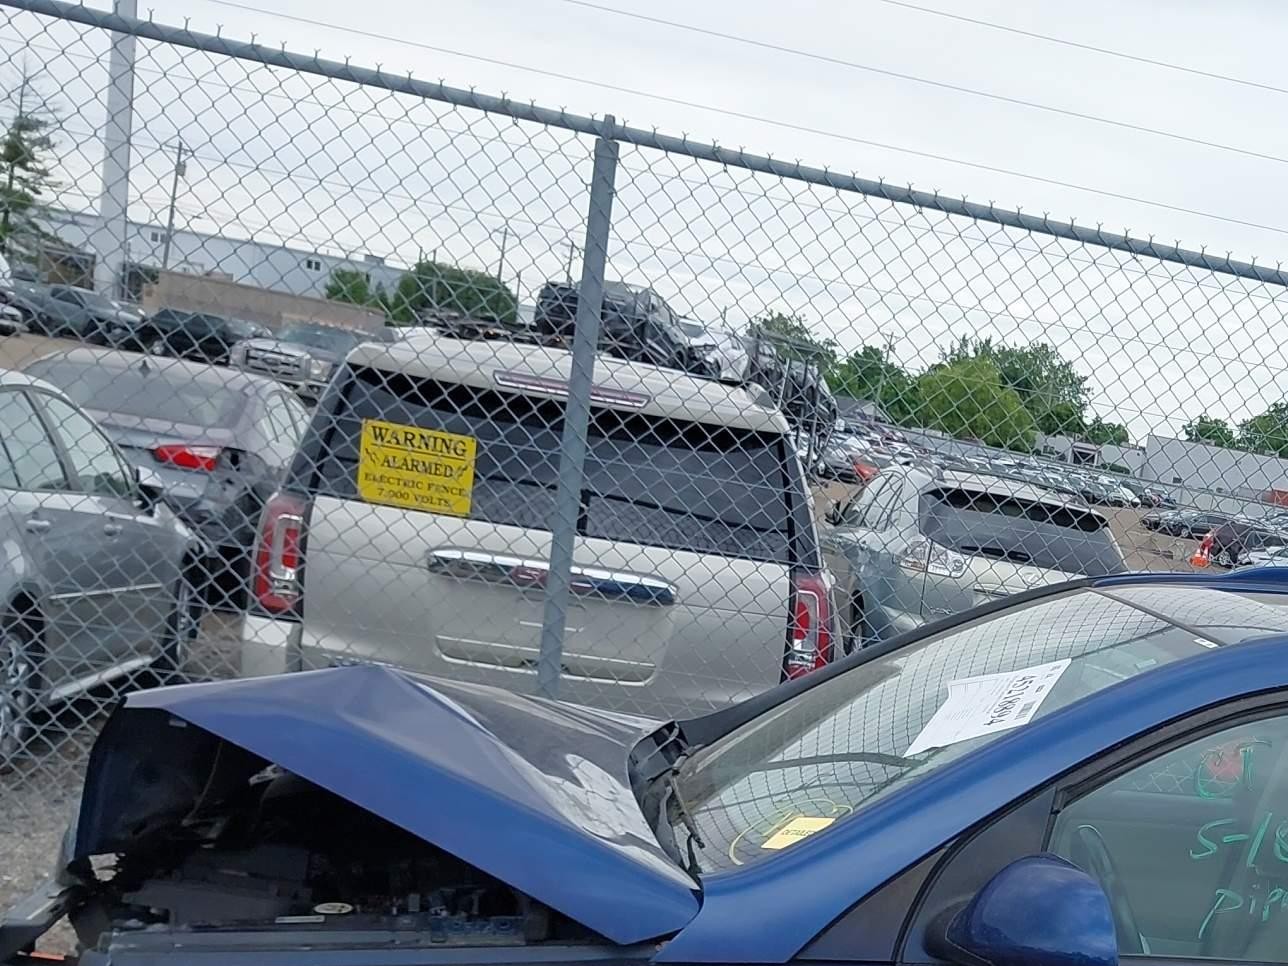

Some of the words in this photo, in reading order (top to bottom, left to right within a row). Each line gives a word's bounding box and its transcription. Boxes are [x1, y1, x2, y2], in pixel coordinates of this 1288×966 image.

[371, 425, 467, 457] WARNING
[381, 455, 454, 478] ALARMED
[364, 472, 424, 490] ELECTRIC
[427, 482, 467, 497] FENCE
[413, 493, 451, 507] VOLTS
[983, 675, 1037, 726] 45218894
